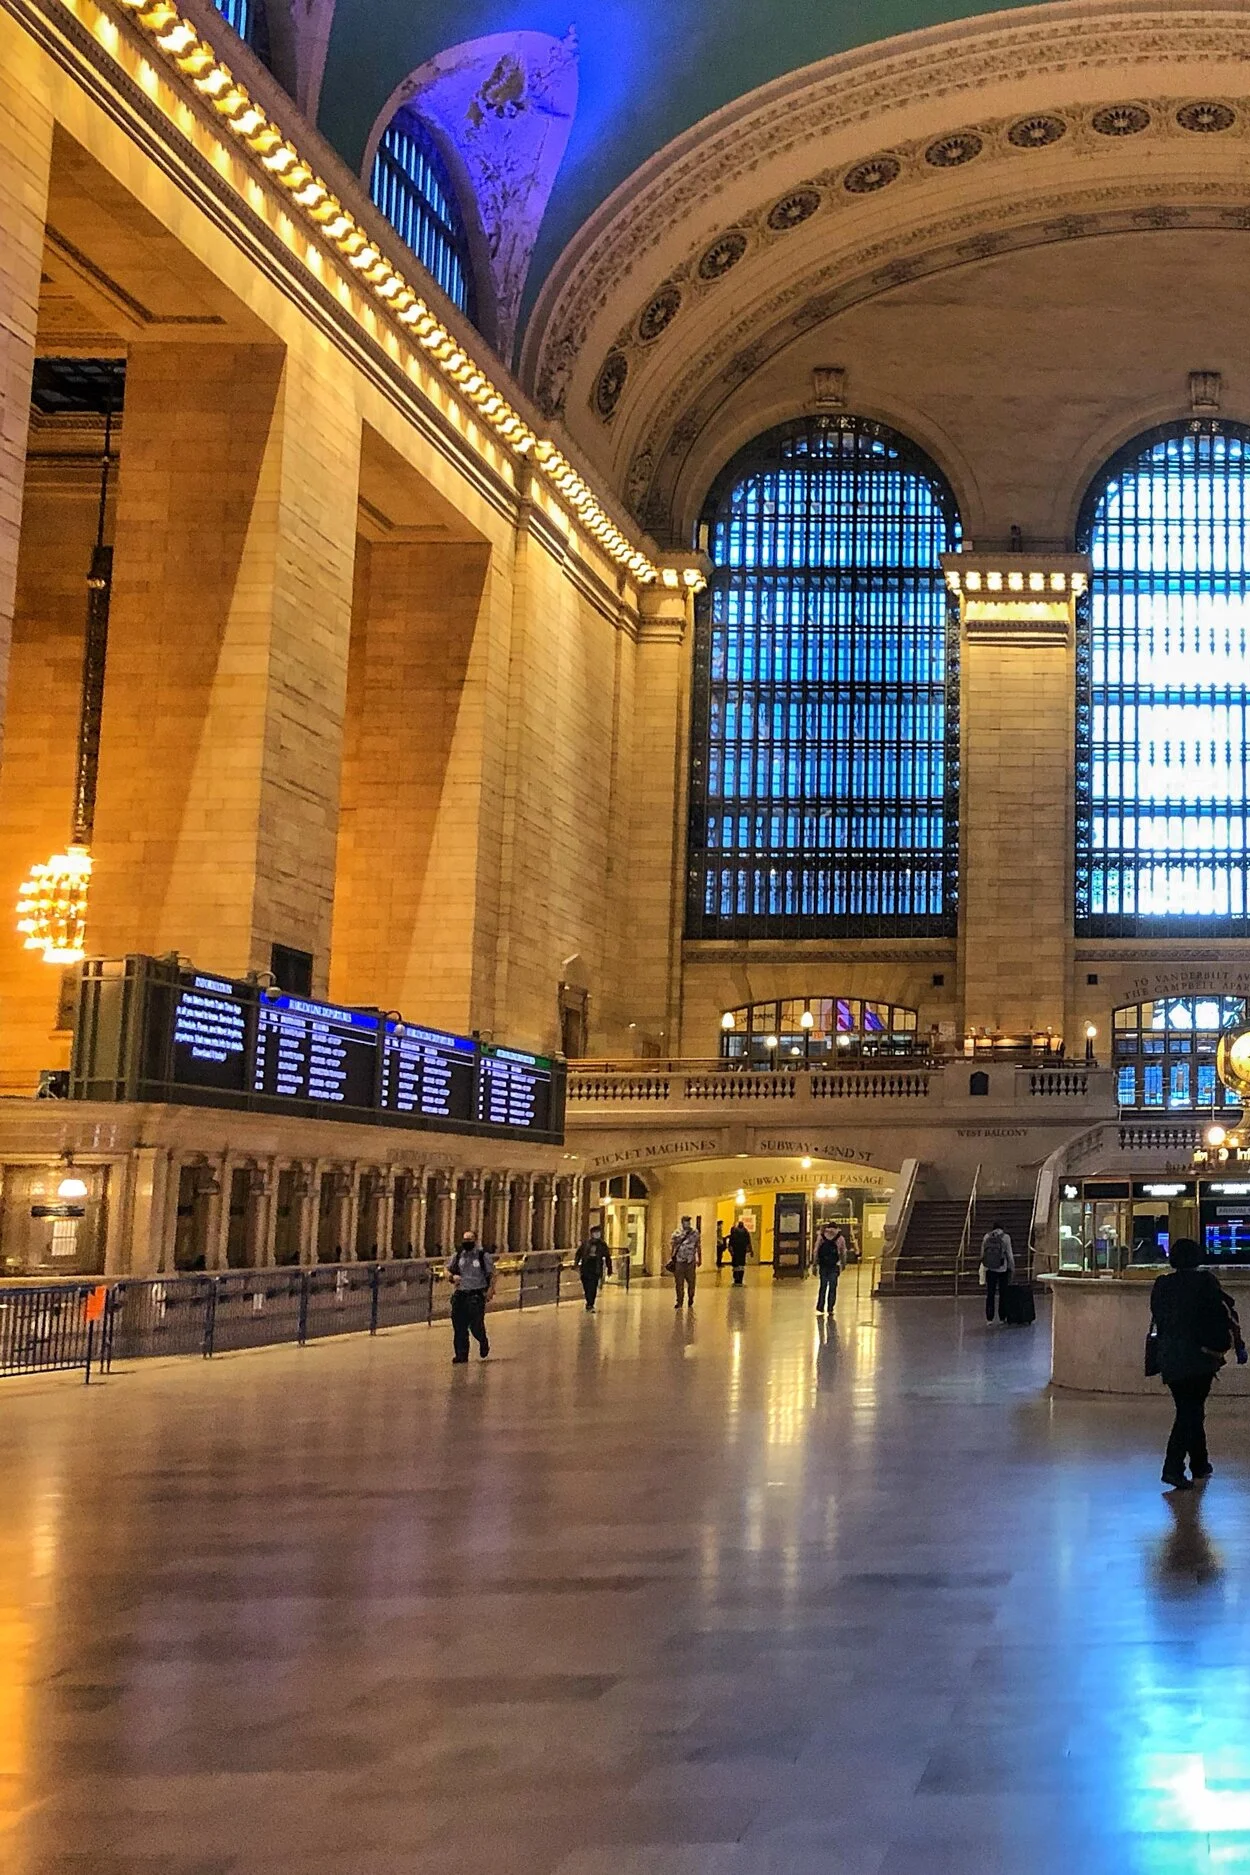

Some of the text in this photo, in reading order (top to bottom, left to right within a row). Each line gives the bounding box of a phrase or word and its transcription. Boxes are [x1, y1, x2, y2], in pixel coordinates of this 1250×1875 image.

[1133, 979, 1149, 987] TO
[1155, 971, 1230, 983] VANDERBILT
[1123, 989, 1149, 1000] THE
[1154, 981, 1217, 994] CAMPBELL
[956, 1129, 1028, 1137] WEST BALCONY
[592, 1139, 716, 1166] TICKET MACHINES
[760, 1140, 875, 1162] SUBWAY 42ND ST
[742, 1173, 885, 1187] SUBWAY SHUTTLE PASSAGE
